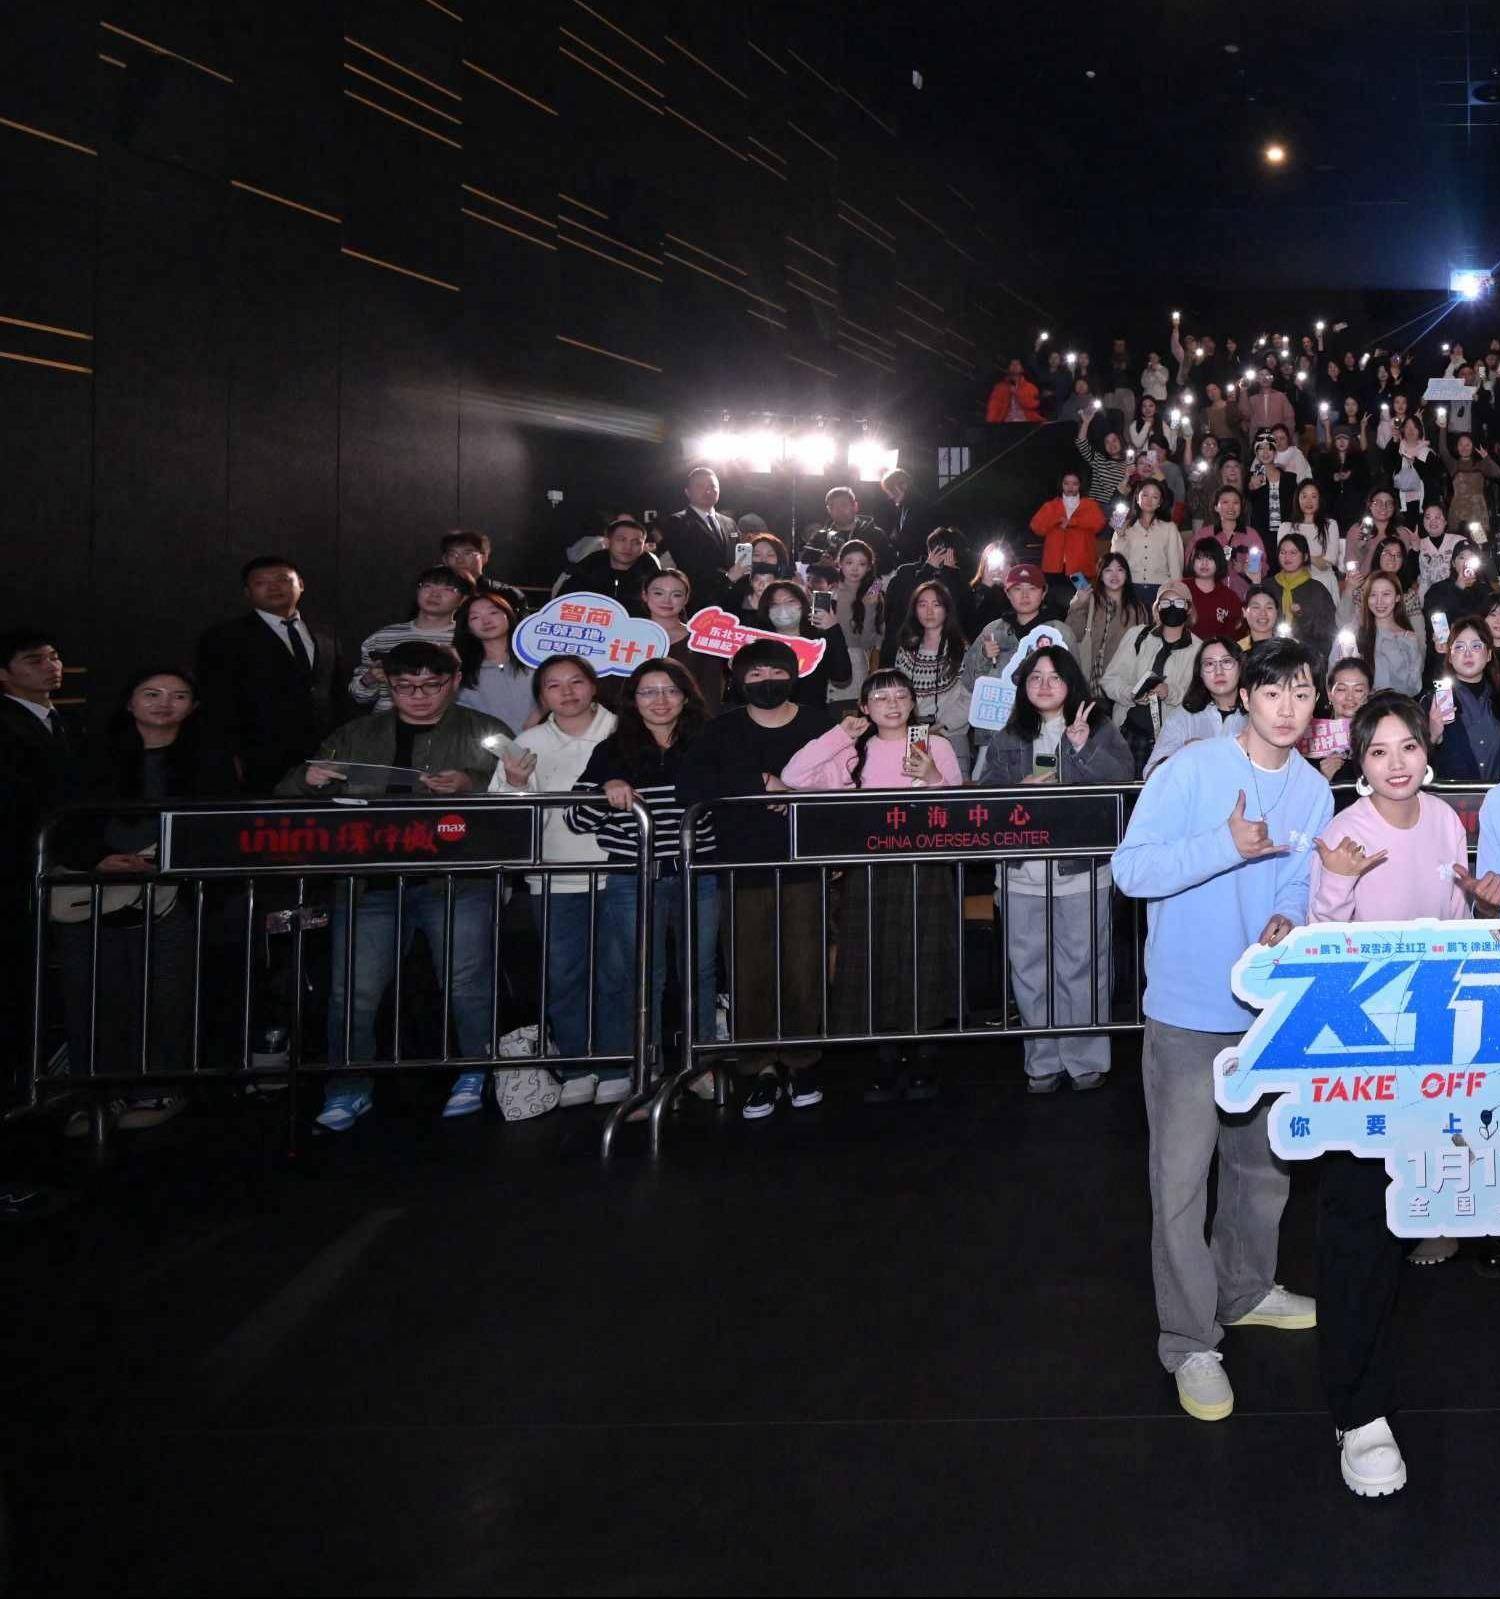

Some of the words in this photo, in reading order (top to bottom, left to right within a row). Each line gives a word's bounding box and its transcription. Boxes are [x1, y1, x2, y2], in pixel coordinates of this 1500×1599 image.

[559, 602, 613, 627] 智商
[437, 821, 466, 833] max
[886, 803, 1031, 830] 中海中心
[867, 835, 912, 850] CHINA
[915, 832, 990, 849] OVERSEAS
[993, 830, 1049, 846] CENTER
[1361, 943, 1392, 954] 双雪涛
[1311, 1074, 1396, 1103] TAKE
[1420, 1072, 1487, 1098] OFF
